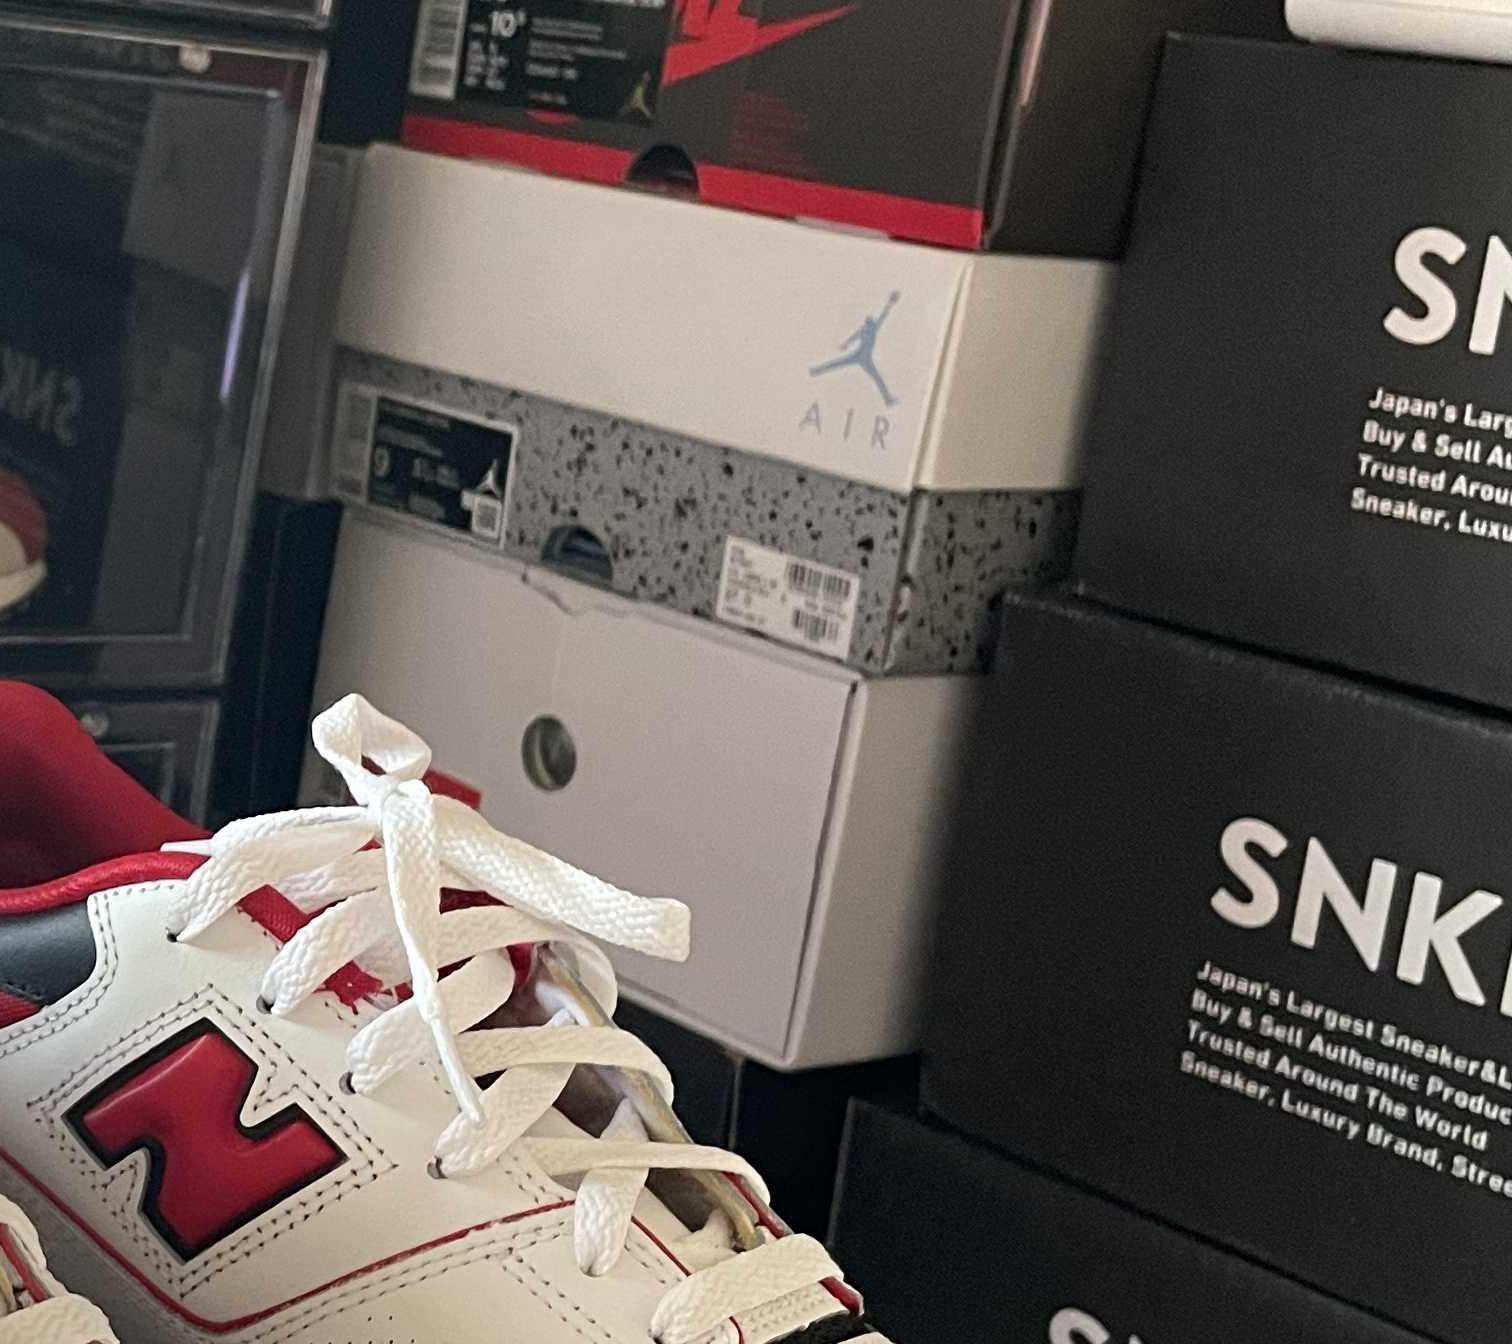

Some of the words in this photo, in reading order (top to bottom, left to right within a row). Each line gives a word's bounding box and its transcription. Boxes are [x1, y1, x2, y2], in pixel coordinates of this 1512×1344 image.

[798, 401, 890, 449] AIR
[1368, 387, 1458, 423] Japan's
[1363, 419, 1406, 453] Buy
[1411, 429, 1427, 453] &
[1434, 434, 1481, 464] Sell
[1358, 453, 1447, 492] Trusted
[1450, 475, 1512, 506] Arou
[1210, 817, 1512, 1017] SNK
[1197, 960, 1280, 1006] Japan's
[1285, 990, 1374, 1041] Largest
[1192, 988, 1233, 1025] Buy
[1238, 1006, 1253, 1029] &
[1259, 1014, 1303, 1048] Sell
[1307, 1033, 1420, 1091] Authentic
[1188, 1019, 1272, 1069] Trusted
[1274, 1056, 1359, 1103] Around
[1366, 1085, 1409, 1120] The
[1415, 1105, 1488, 1151] World
[1281, 1088, 1361, 1140] Luxury
